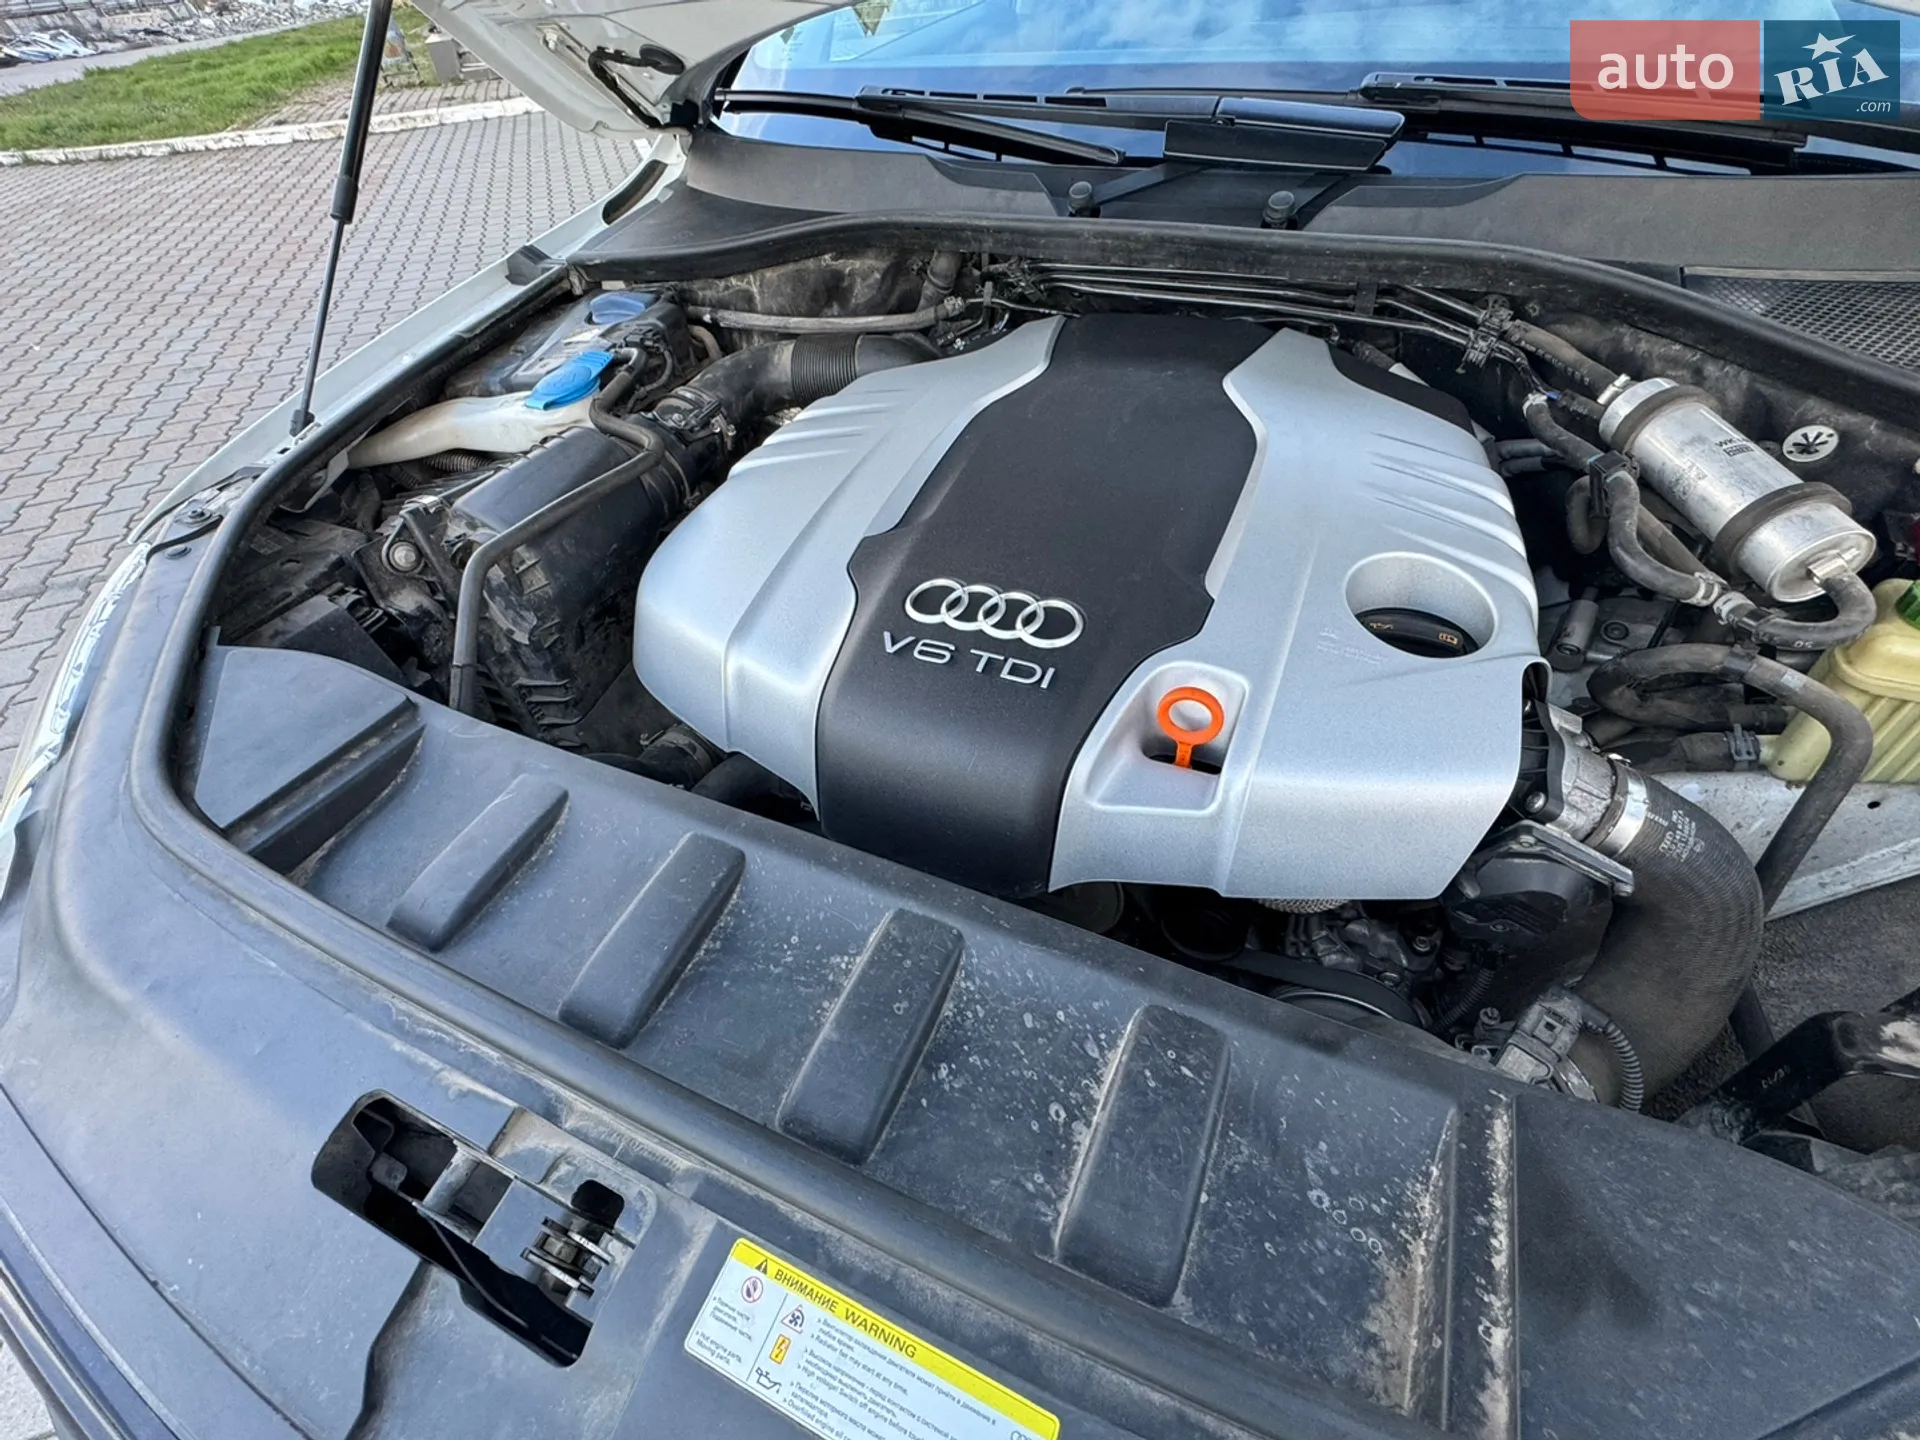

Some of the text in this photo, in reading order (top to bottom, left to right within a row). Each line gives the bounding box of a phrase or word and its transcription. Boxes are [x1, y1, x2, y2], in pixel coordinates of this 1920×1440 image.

[883, 631, 1056, 689] V6 TDI
[774, 1269, 917, 1358] ВНИМАНИЕ WARNING
